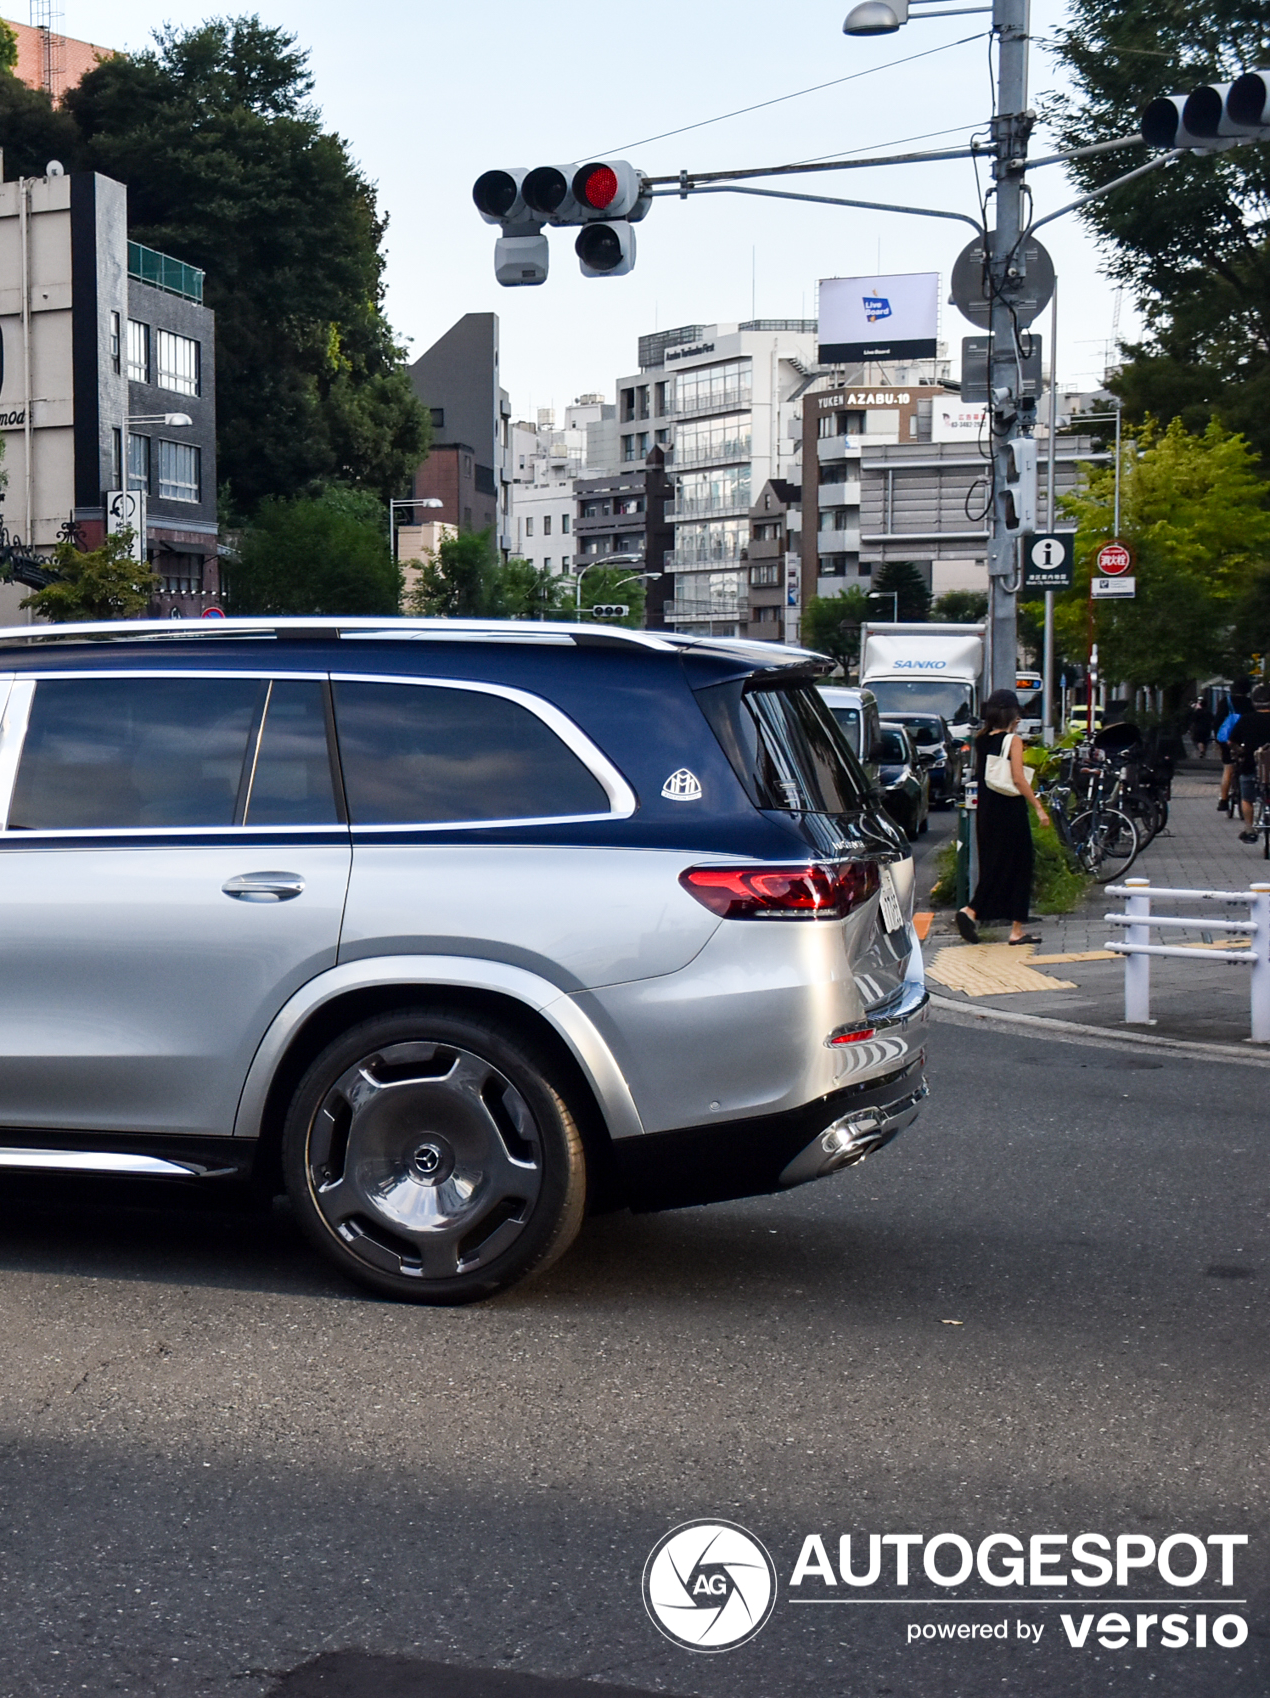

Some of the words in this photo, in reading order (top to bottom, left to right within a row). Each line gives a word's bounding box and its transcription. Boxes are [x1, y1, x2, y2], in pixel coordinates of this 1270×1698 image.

[818, 394, 844, 408] YUKEN
[1100, 554, 1127, 566] 消火栓
[892, 660, 947, 669] SANKO
